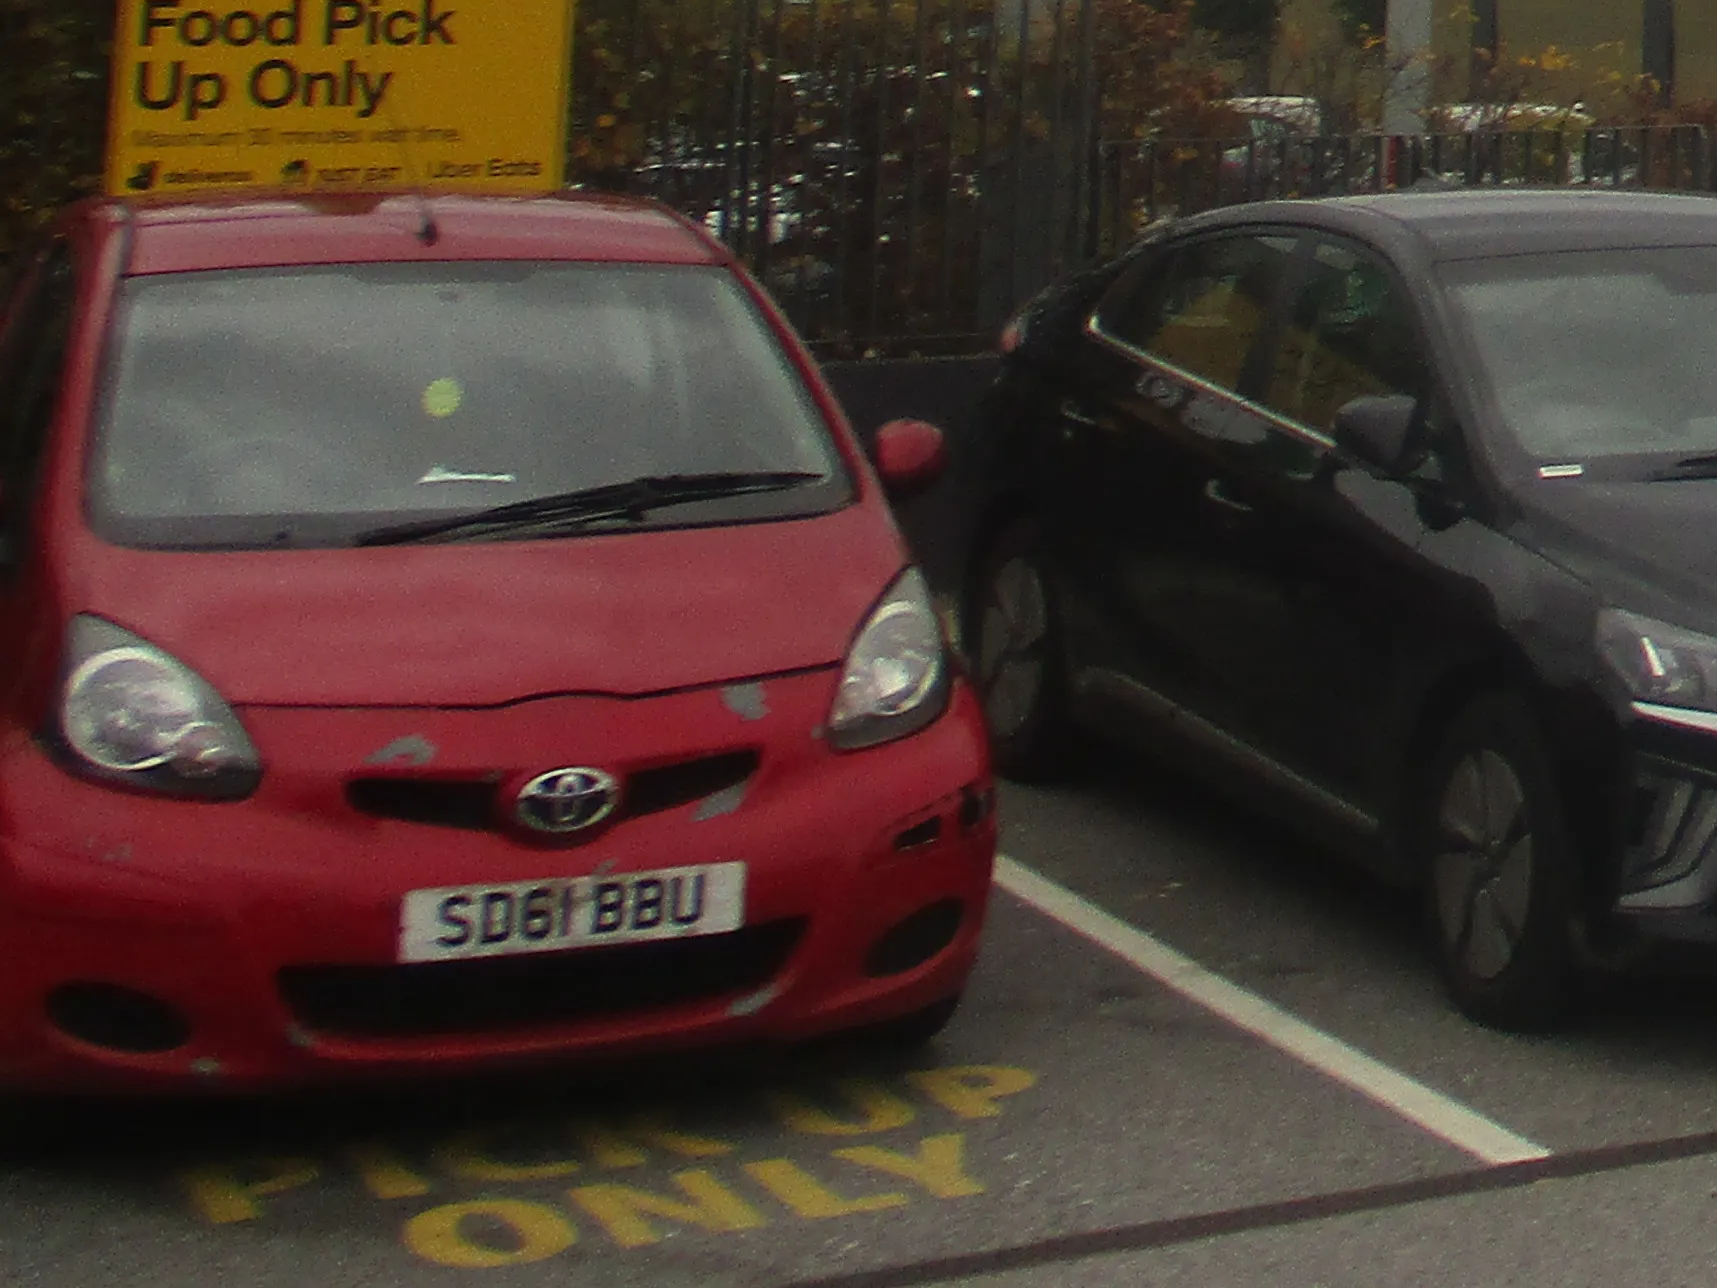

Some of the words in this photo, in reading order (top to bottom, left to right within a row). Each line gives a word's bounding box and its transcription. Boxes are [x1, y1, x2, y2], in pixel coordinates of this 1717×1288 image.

[136, 60, 226, 121] Up
[248, 58, 393, 119] Only
[435, 884, 577, 948] SD61
[591, 873, 705, 935] BBU
[404, 1132, 986, 1268] ONLY
